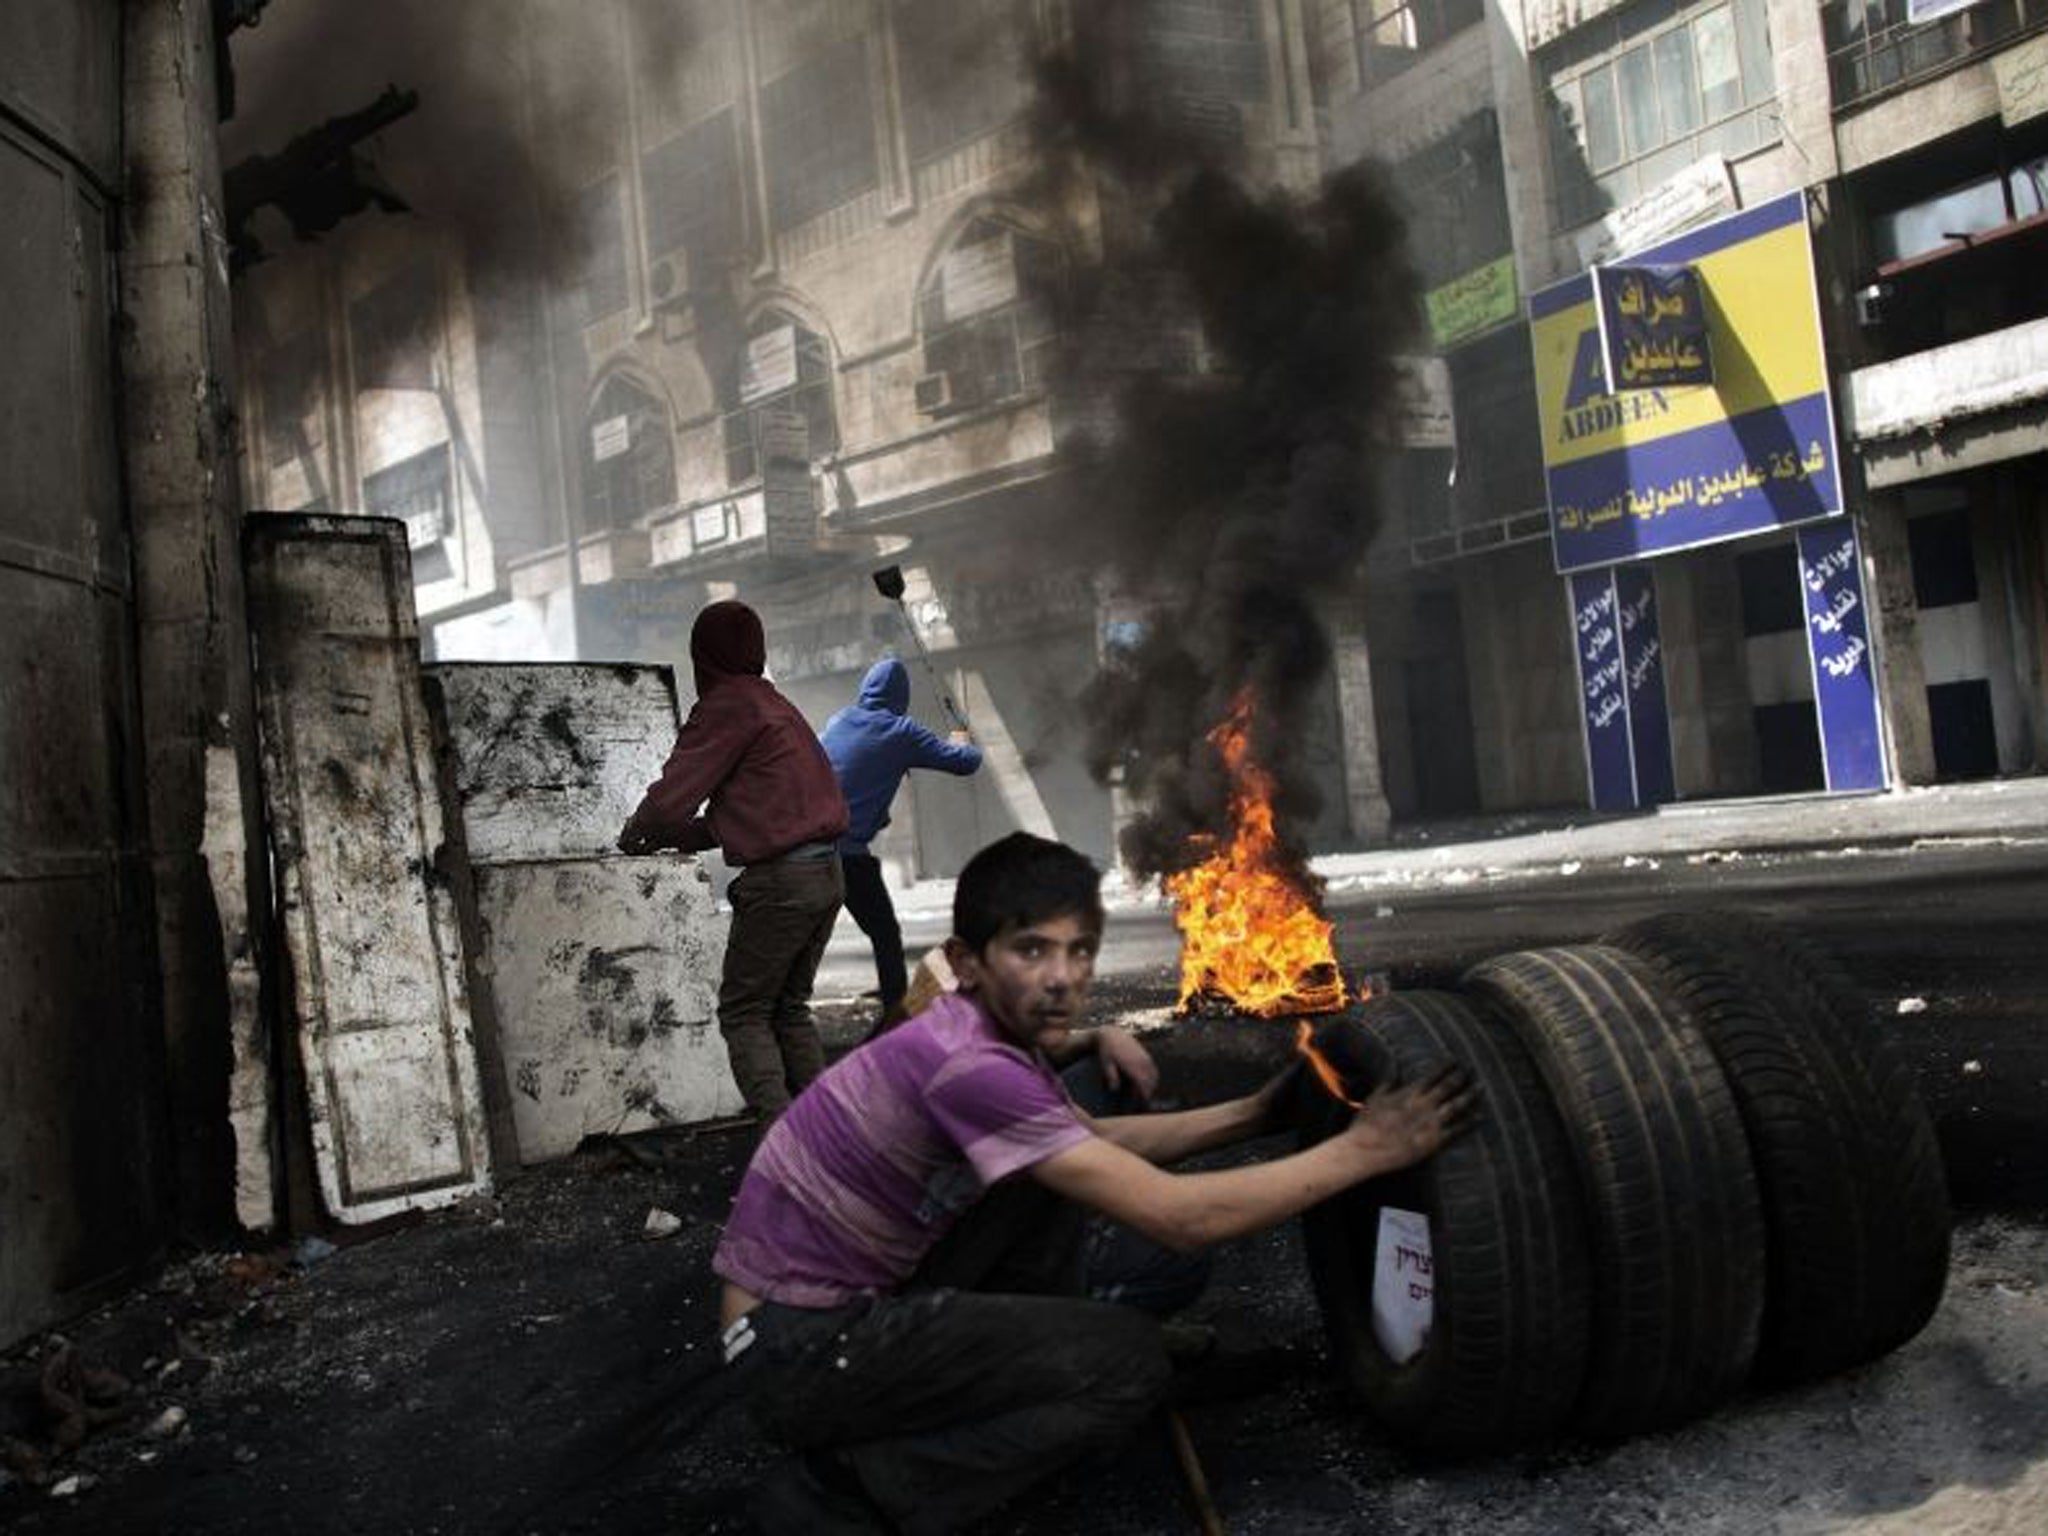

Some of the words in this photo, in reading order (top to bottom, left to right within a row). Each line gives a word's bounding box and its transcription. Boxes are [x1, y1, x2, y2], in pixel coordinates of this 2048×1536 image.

[1622, 335, 1703, 381] عابدين
[1558, 389, 1670, 443] ABDEEN
[1766, 440, 1826, 481] شركة
[1628, 477, 1693, 520] الدولية
[1697, 463, 1767, 506] عابدين
[1805, 539, 1854, 592] حوالات
[1577, 587, 1613, 633] حوالات
[1811, 588, 1858, 633] نقدية
[1585, 657, 1621, 698] حوالات
